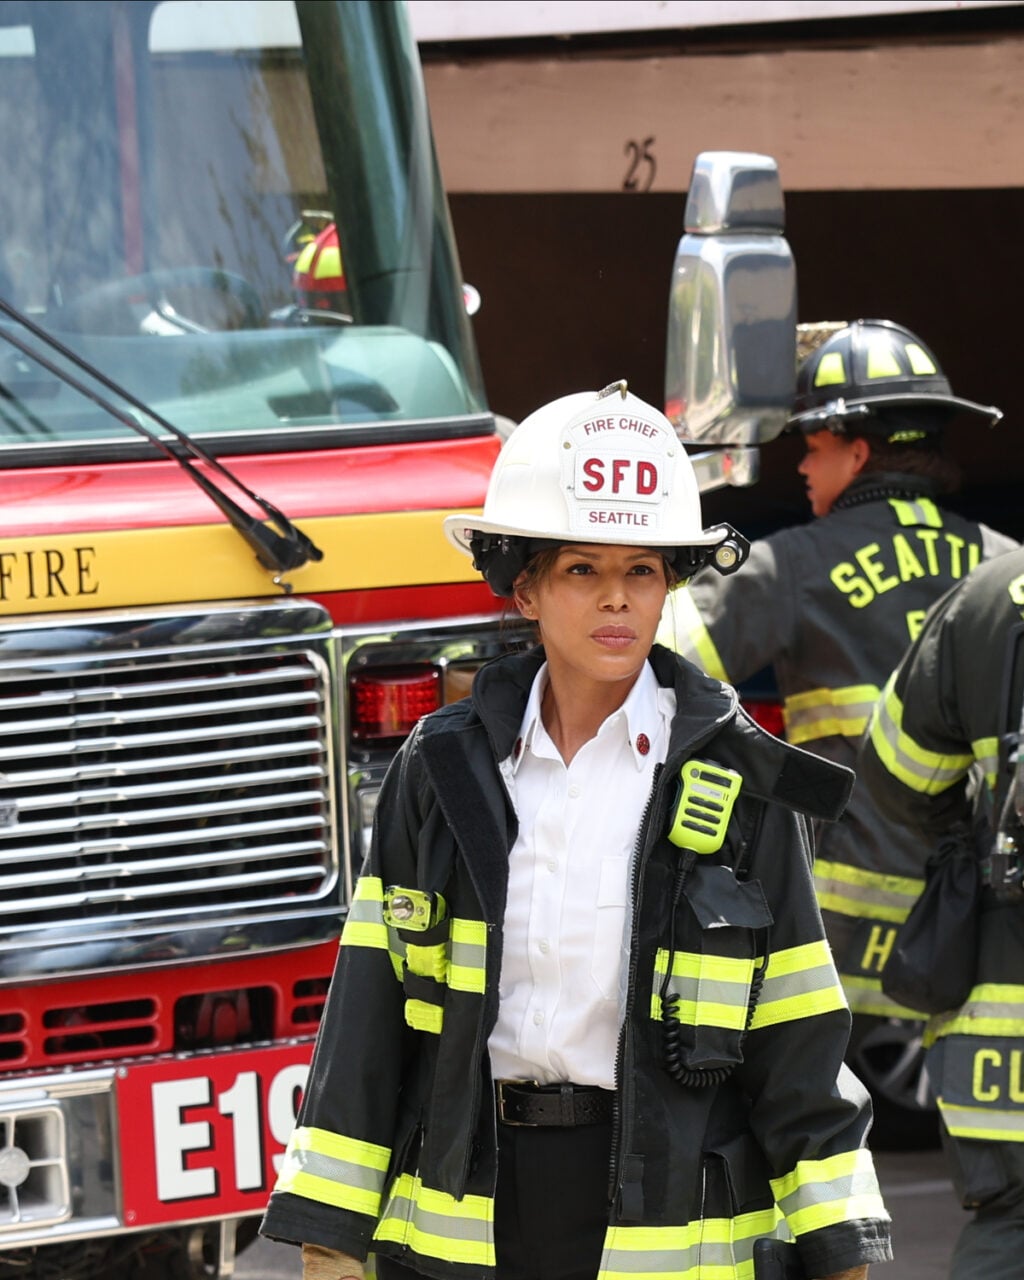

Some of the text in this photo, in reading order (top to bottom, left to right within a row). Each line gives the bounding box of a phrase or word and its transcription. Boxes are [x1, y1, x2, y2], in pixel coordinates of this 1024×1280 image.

[622, 136, 657, 191] 25
[584, 418, 659, 439] FIRE CHIEF
[582, 458, 658, 495] SFD
[589, 511, 649, 527] SEATTLE
[0, 546, 100, 601] FIRE
[830, 529, 980, 609] SEATT
